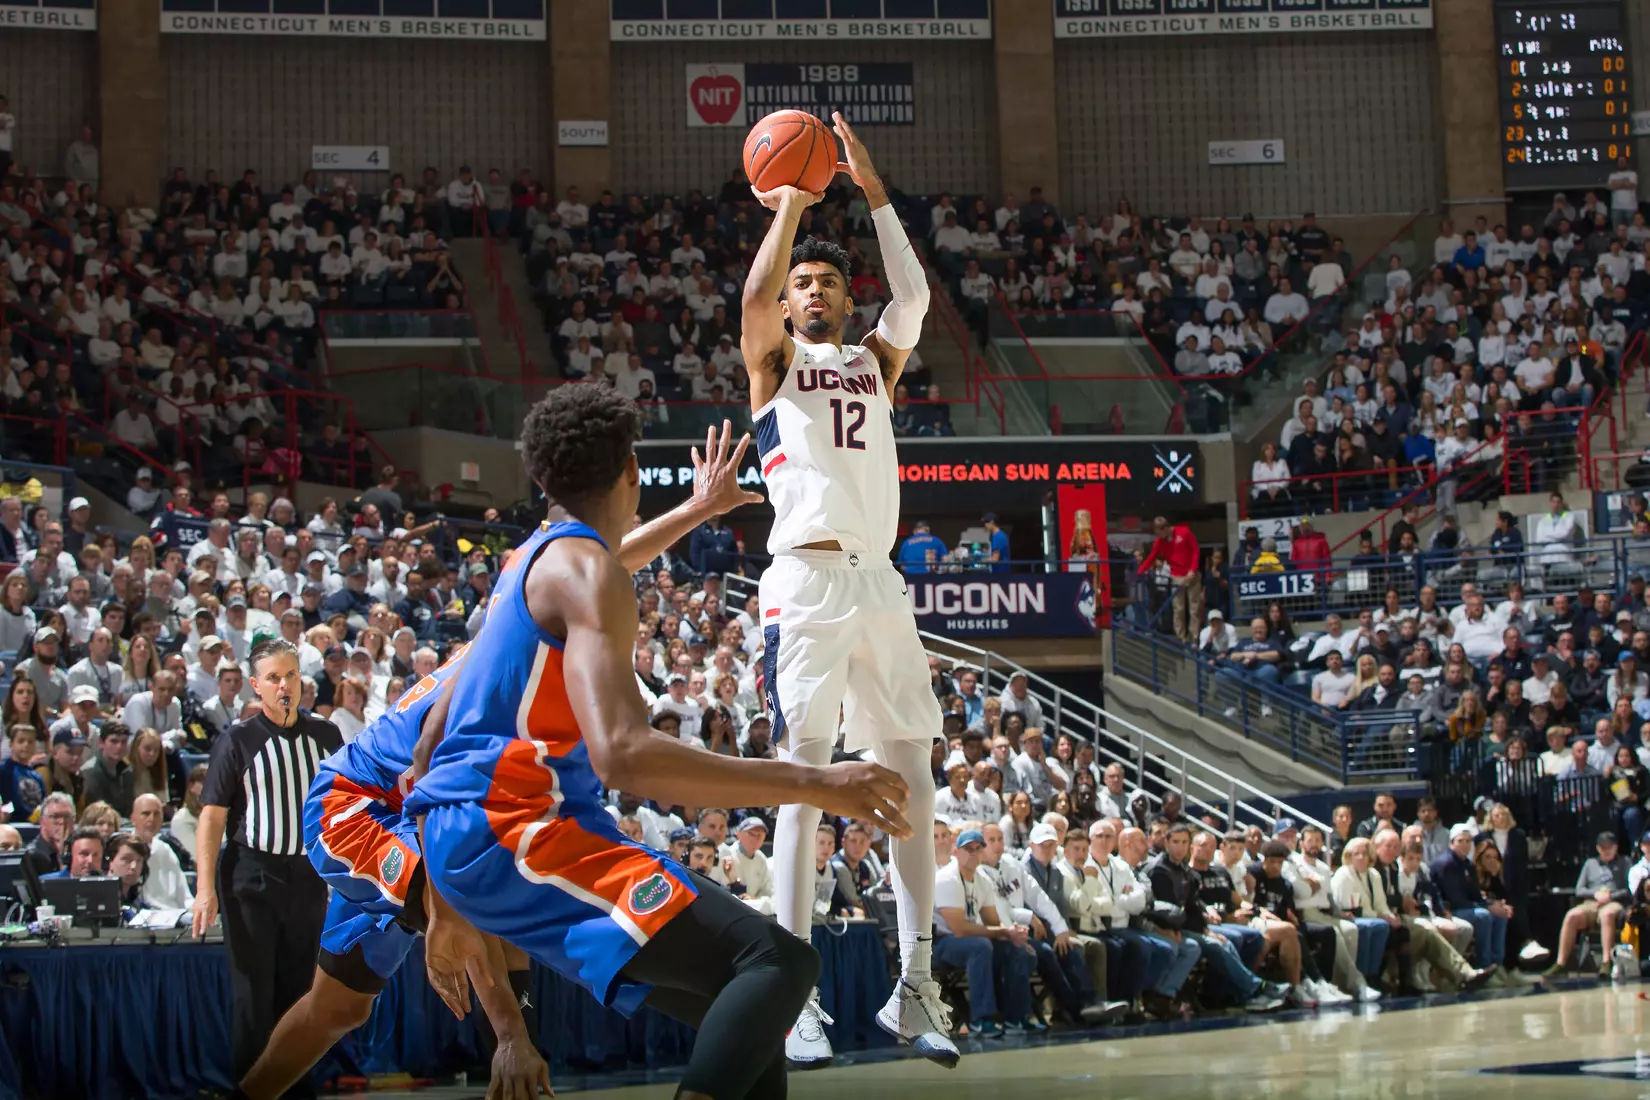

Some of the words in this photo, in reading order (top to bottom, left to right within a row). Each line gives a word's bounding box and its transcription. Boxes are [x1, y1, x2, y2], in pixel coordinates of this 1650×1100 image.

[172, 16, 318, 33] CONNECTICUT
[329, 20, 391, 35] MEN'S
[402, 22, 534, 37] BASKETBALL
[622, 23, 767, 37] CONNECTICUT
[776, 23, 838, 37] MEN'S
[848, 22, 980, 37] BASKETBALL
[1066, 17, 1208, 34] CONNECTICUT
[1219, 16, 1282, 31] MEN'S
[1290, 13, 1422, 30] BASKETBALL
[798, 65, 859, 82] 1988
[698, 87, 736, 106] NIT
[747, 85, 817, 103] NATIONAL
[828, 85, 913, 103] INVITATION
[843, 105, 913, 123] CHAMPION
[560, 128, 606, 139] SOUTH
[314, 151, 340, 162] SEC
[366, 150, 380, 166] 4
[1210, 146, 1236, 158] SEC
[1262, 142, 1275, 159] 6
[830, 398, 866, 450] 12
[1006, 464, 1049, 481] SUN
[1057, 463, 1132, 480] ARENA
[1240, 581, 1266, 594] SEC
[1278, 573, 1315, 594] 113
[907, 582, 1046, 615] UCONN
[947, 619, 1009, 630] HUSKIES
